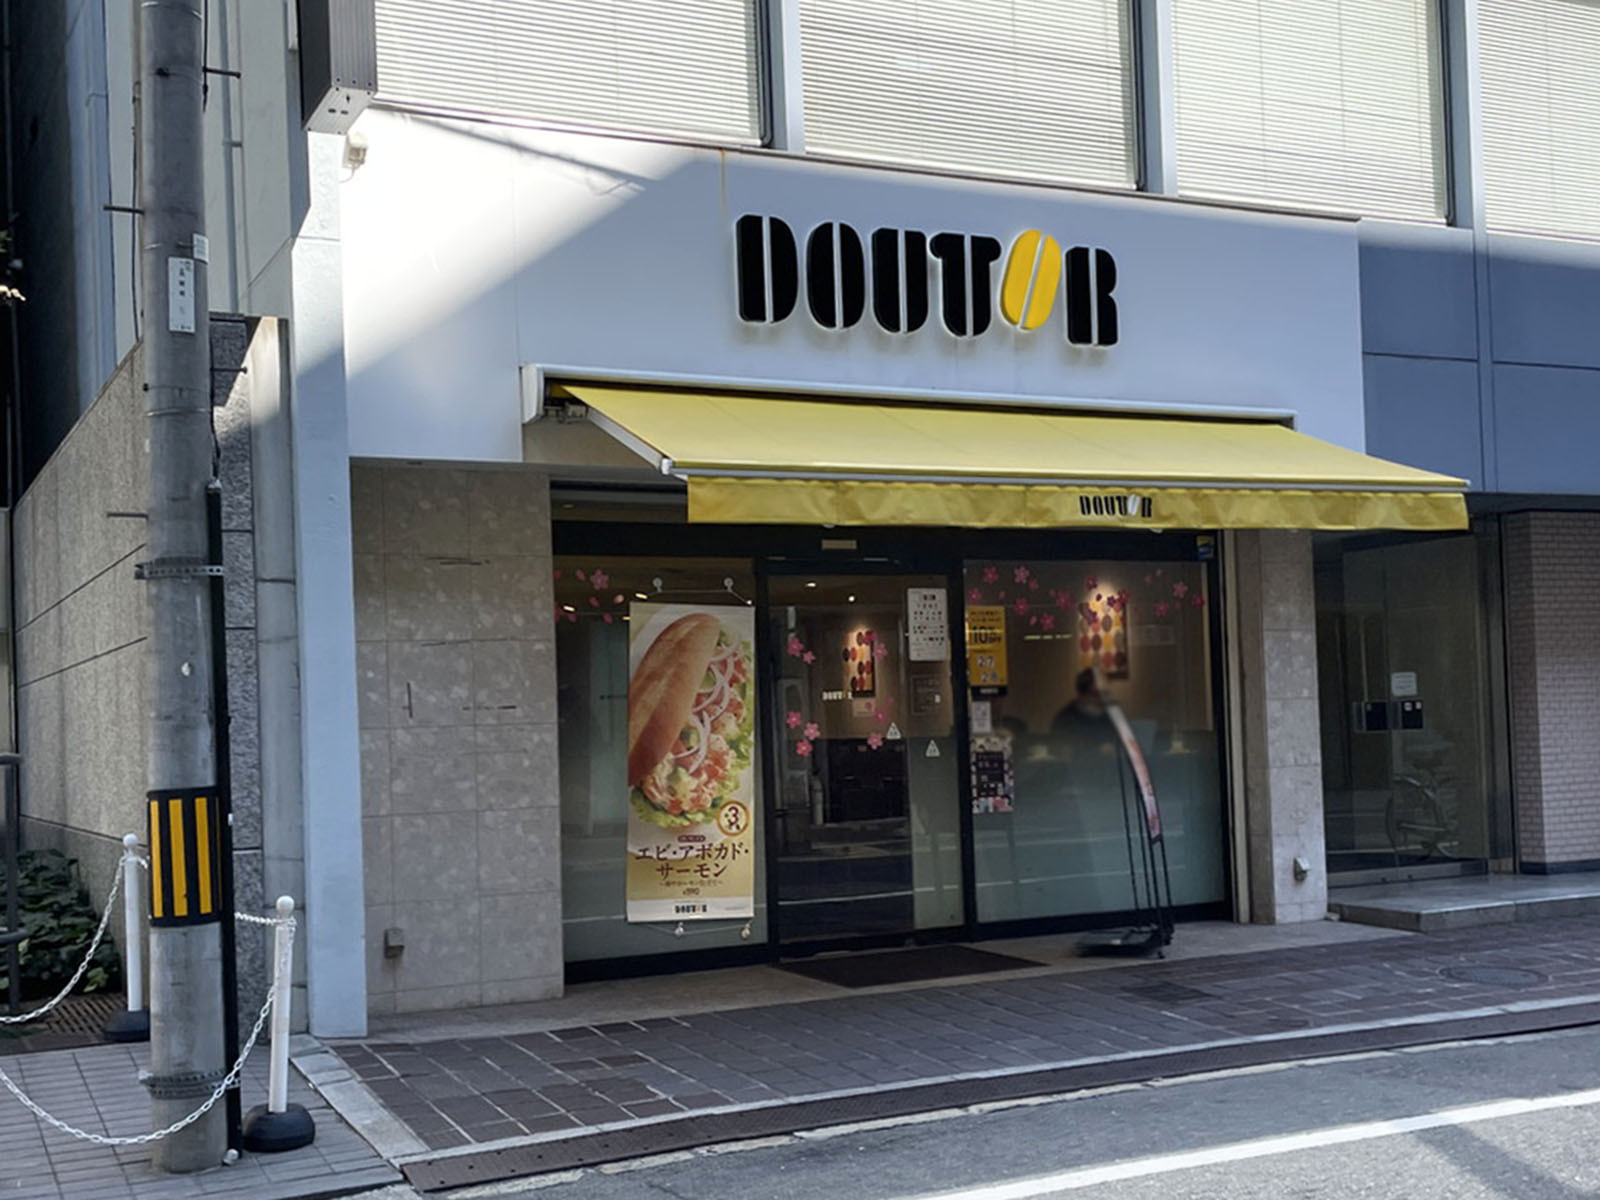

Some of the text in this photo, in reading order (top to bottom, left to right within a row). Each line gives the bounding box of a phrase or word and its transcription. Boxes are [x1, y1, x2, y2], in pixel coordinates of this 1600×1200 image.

[735, 214, 1119, 346] DOUTOR
[1080, 494, 1152, 518] DOUTOR
[656, 863, 728, 880] サーモン
